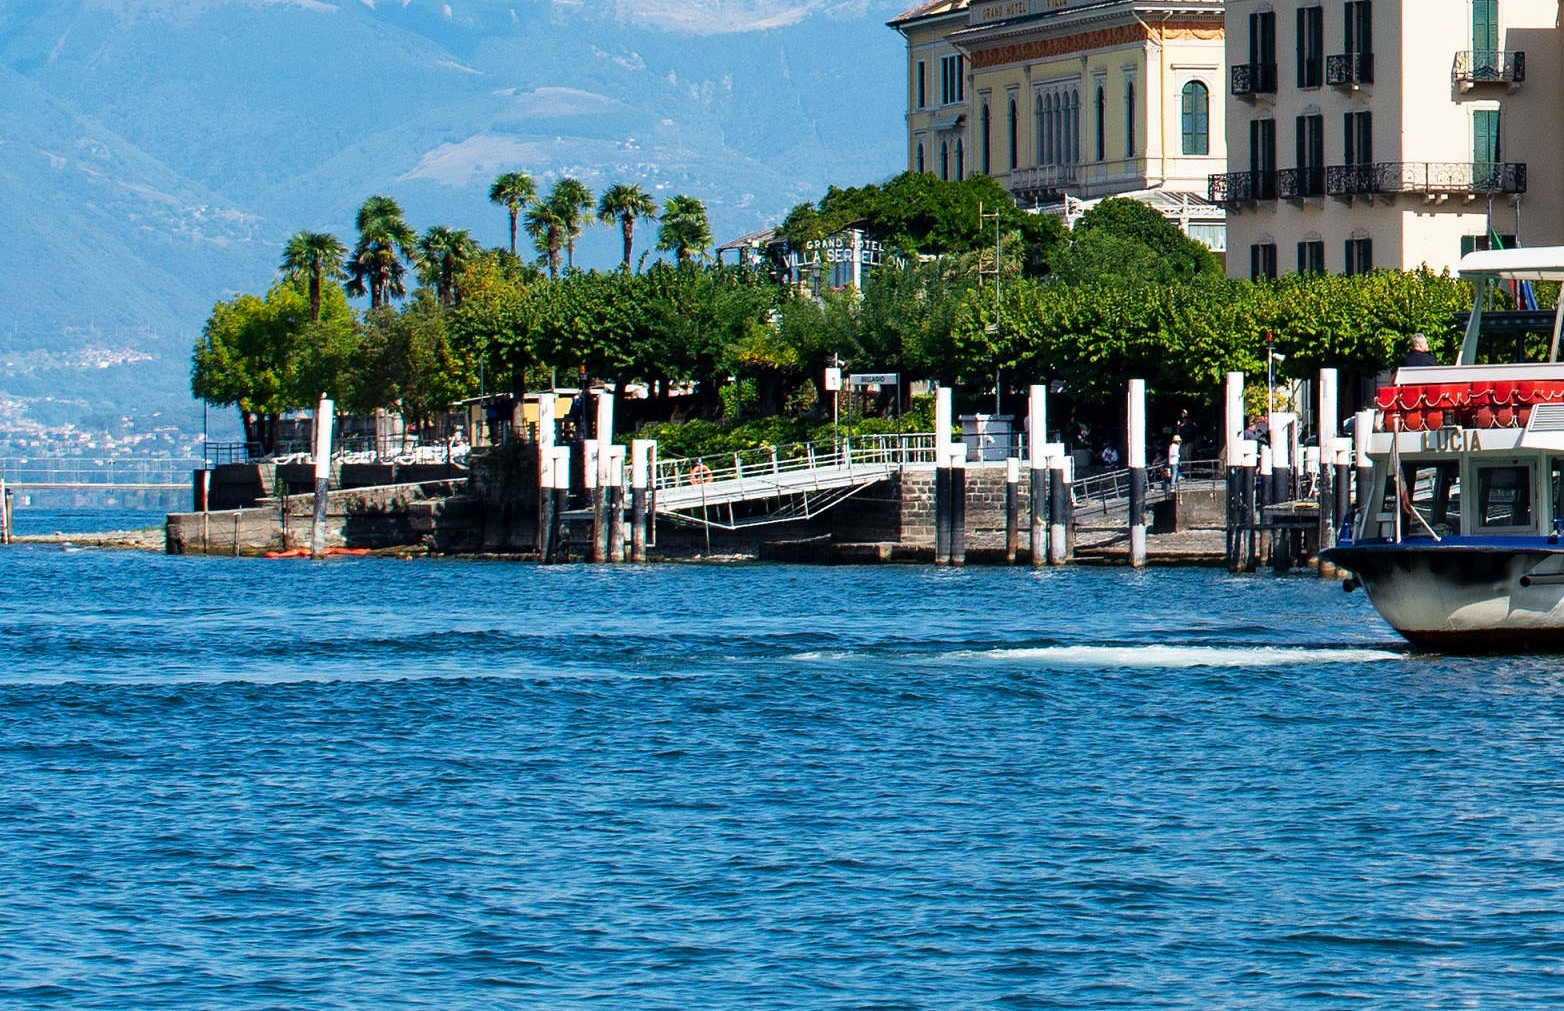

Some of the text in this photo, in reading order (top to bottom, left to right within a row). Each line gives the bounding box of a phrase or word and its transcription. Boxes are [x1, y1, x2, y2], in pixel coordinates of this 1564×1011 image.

[983, 6, 1002, 20] GRAND
[1006, 2, 1027, 15] HOTEL
[806, 239, 885, 252] GRAND HOTEL
[1422, 429, 1482, 451] LUCIA
